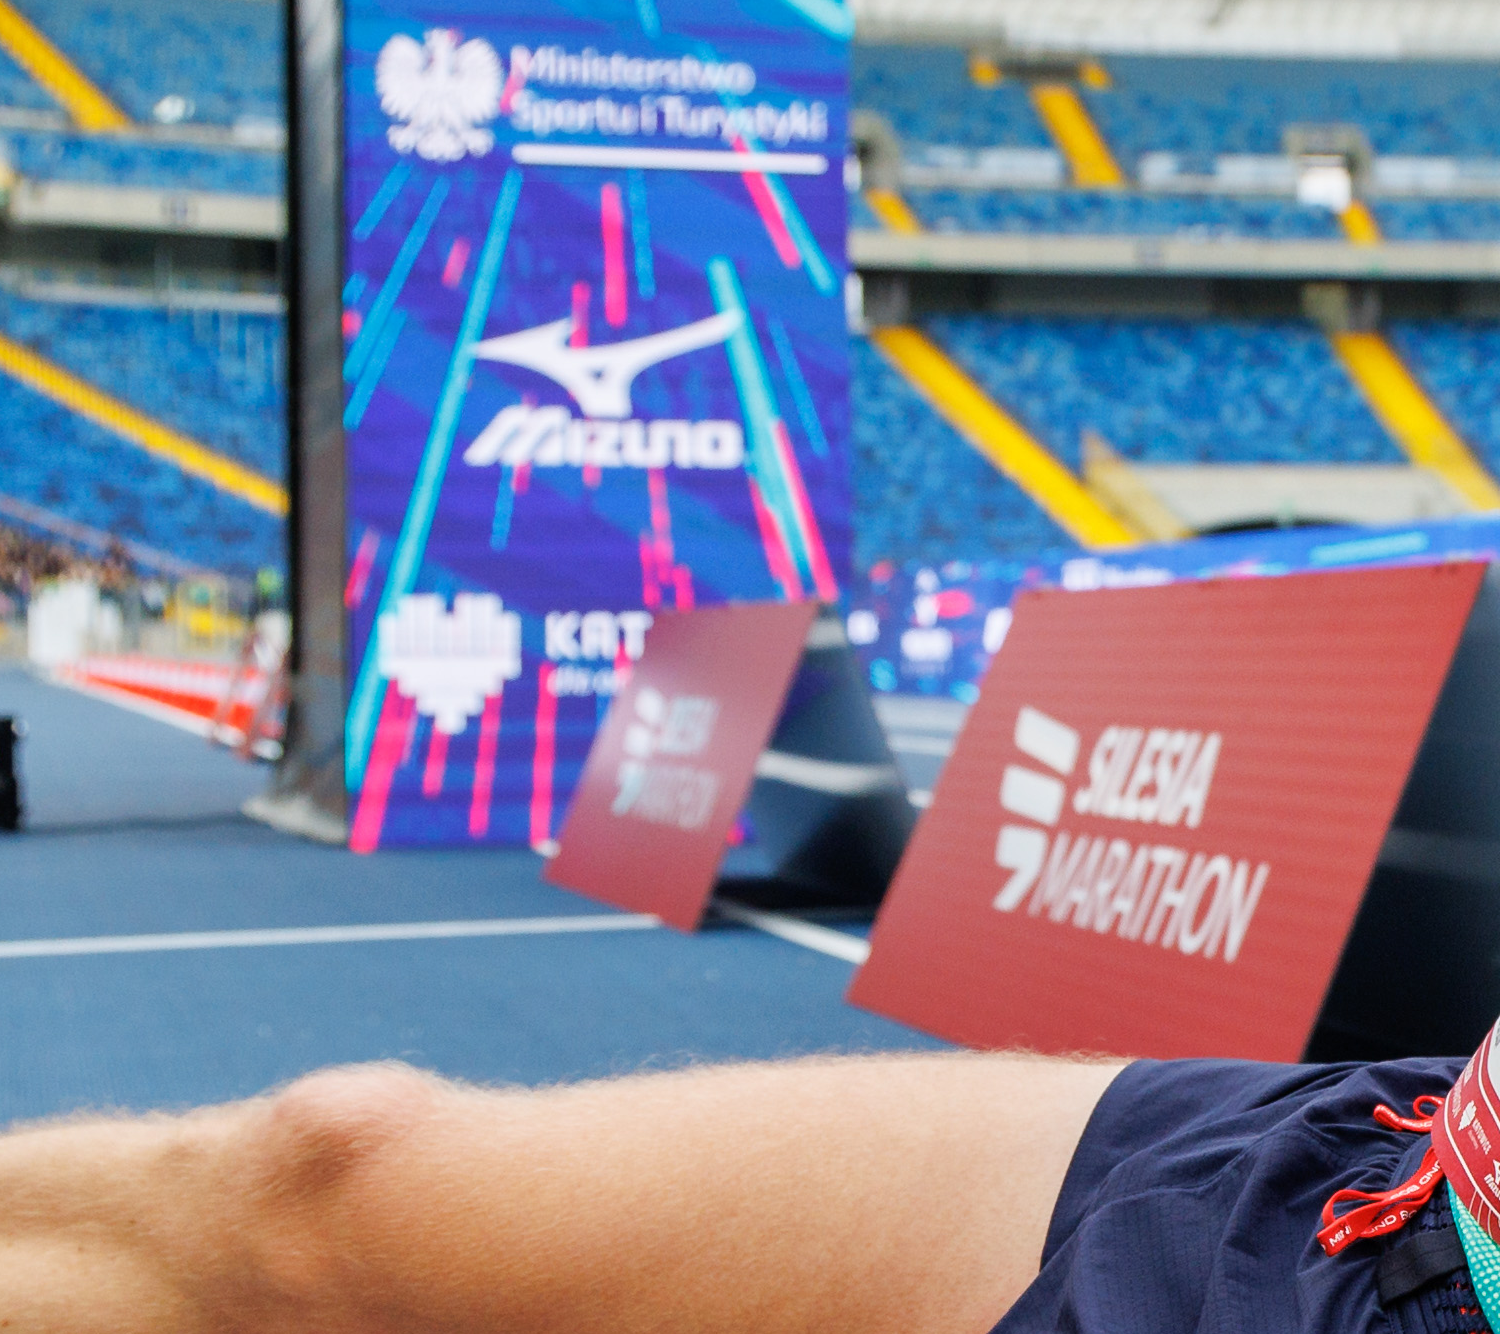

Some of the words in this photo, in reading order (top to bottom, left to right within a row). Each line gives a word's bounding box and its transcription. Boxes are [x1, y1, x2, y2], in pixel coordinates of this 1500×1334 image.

[510, 45, 756, 96] Ministerstwo
[510, 88, 639, 137] Sportu
[659, 94, 828, 147] Turystyki
[545, 610, 654, 661] KAT
[1074, 725, 1221, 829] SILESIA
[1029, 831, 1269, 963] MARATHON
